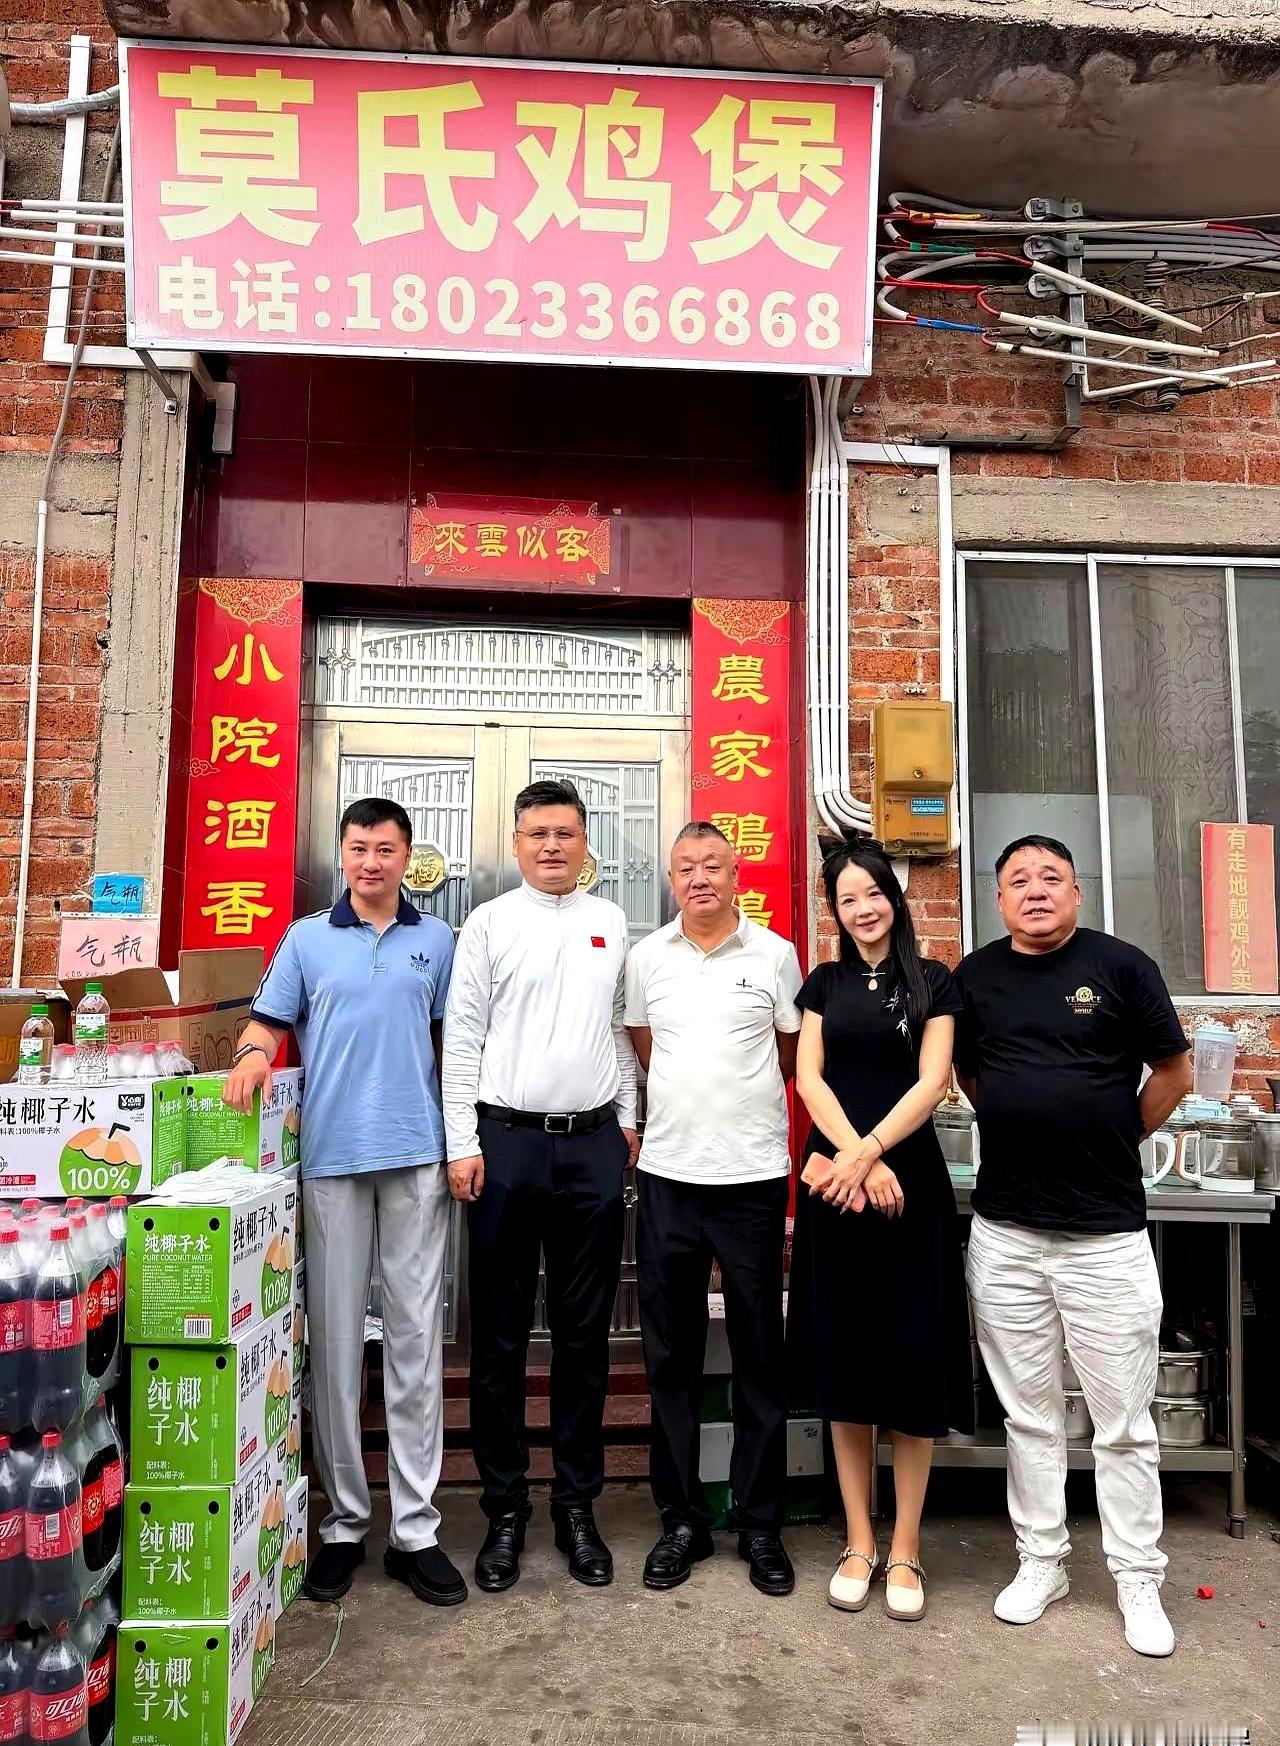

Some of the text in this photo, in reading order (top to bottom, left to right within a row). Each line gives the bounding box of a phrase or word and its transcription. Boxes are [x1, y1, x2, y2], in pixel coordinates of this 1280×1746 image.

[157, 65, 844, 270] 莫氏鸡煲
[157, 256, 842, 350] 电话:18023366868
[201, 633, 285, 936] 小院酒香
[101, 881, 140, 906] 气瓶
[1227, 827, 1253, 990] 有走地靓鸡外卖
[76, 935, 143, 967] 气瓶
[67, 1167, 130, 1191] 100%
[144, 1234, 211, 1254] 纯椰子水
[233, 1202, 277, 1252] 纯椰子水
[264, 1274, 288, 1312] 100%
[240, 1329, 277, 1390] 纯椰子水
[267, 1400, 288, 1439] 100%
[260, 1532, 282, 1572] 100%
[282, 1570, 303, 1604] 100%
